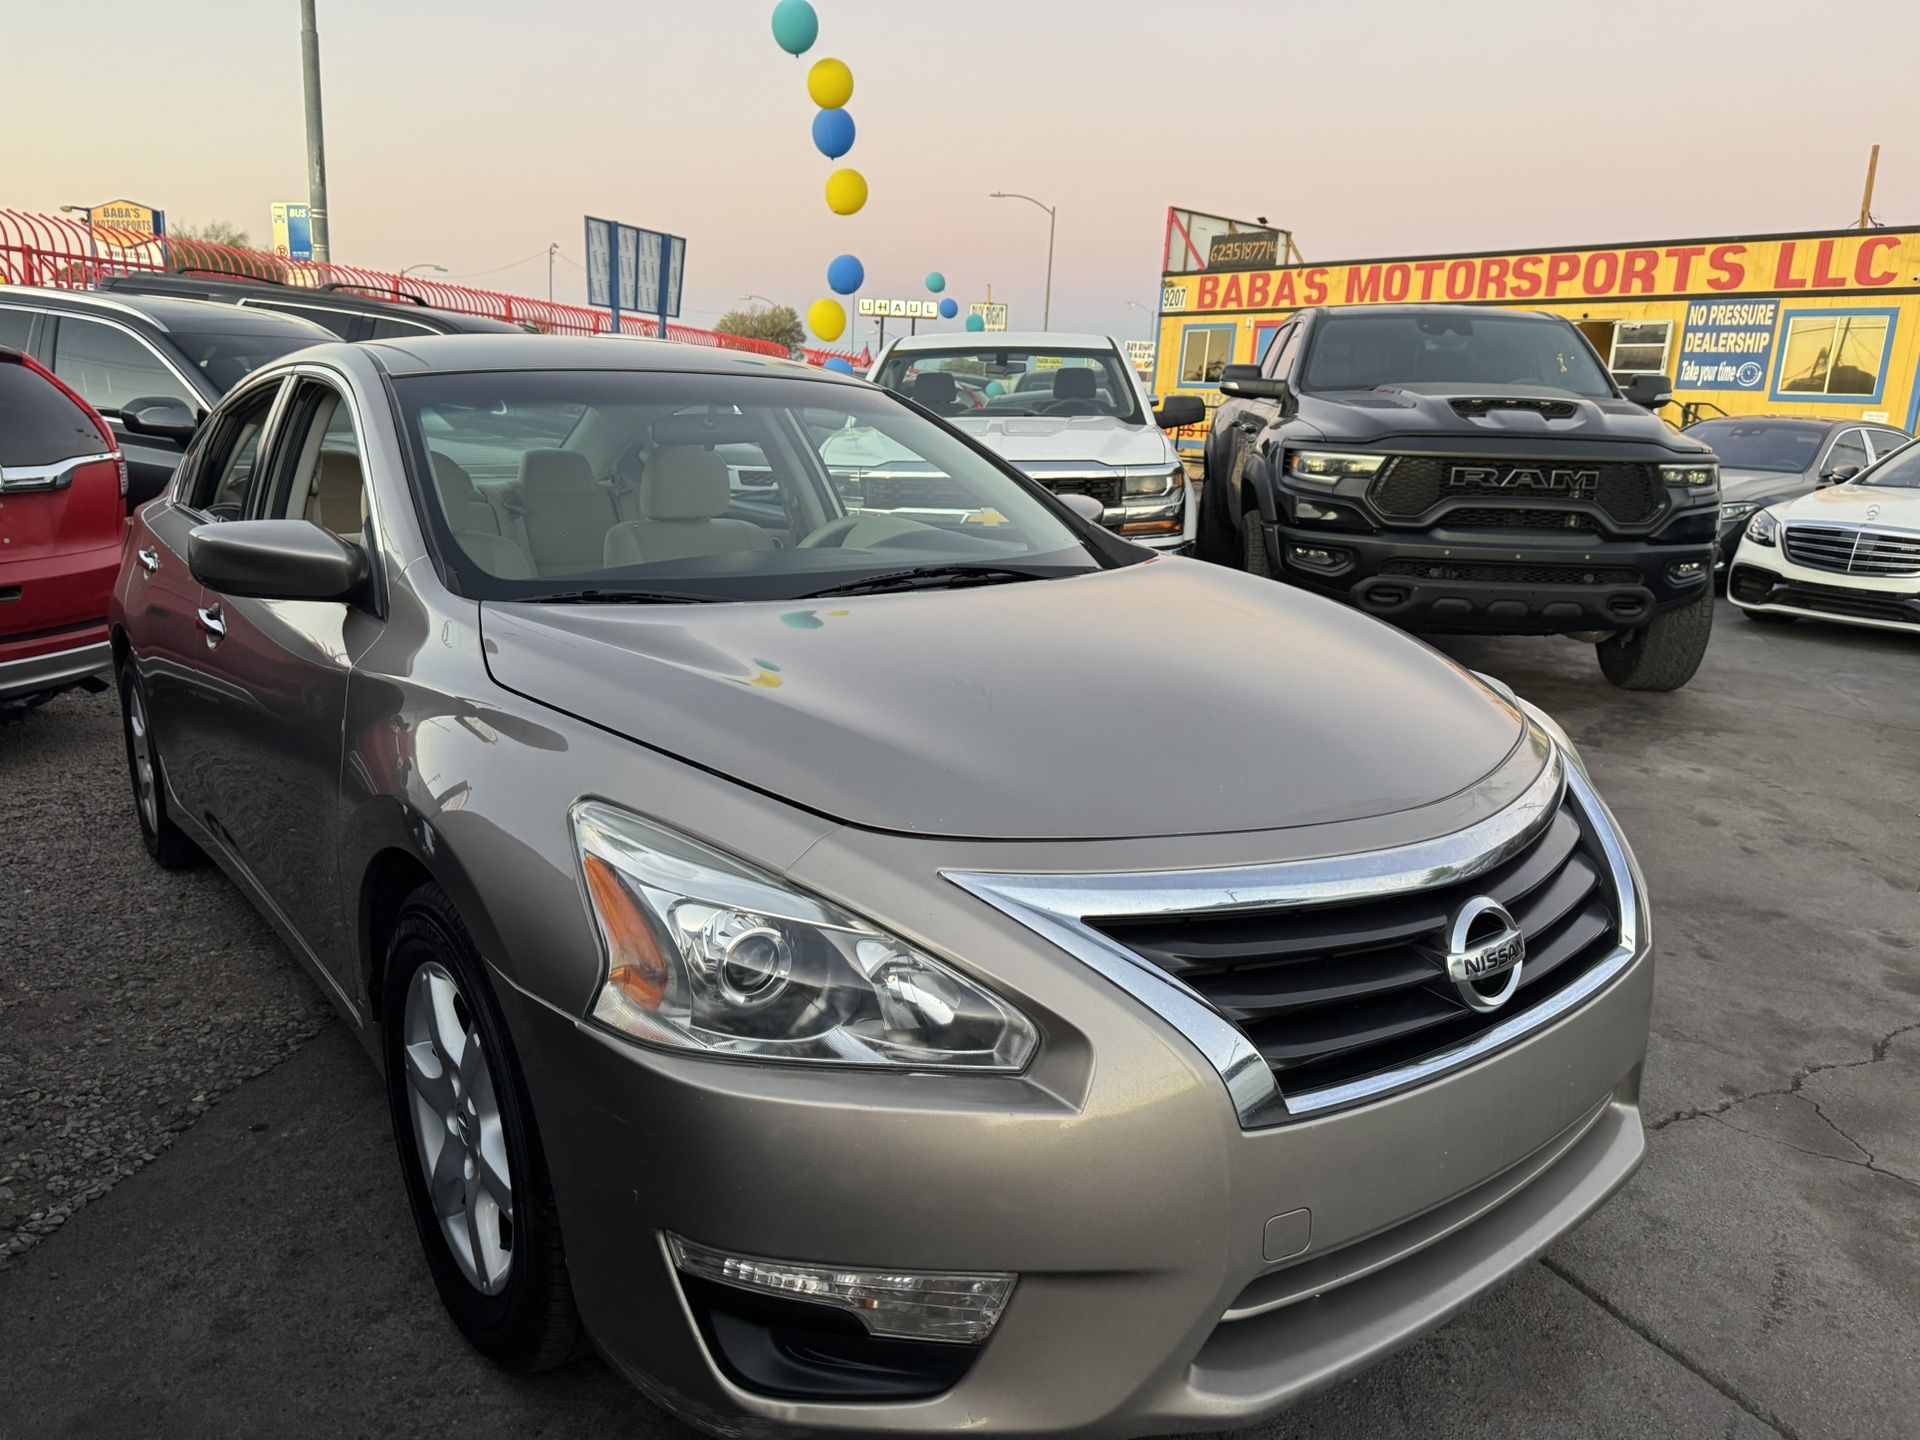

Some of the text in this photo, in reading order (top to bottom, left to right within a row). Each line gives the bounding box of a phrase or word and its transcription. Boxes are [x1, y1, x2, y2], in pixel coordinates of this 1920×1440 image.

[103, 207, 141, 218] BABA'S
[290, 208, 306, 217] BUS
[94, 220, 152, 231] MOTORSPORTS
[1197, 237, 1902, 310] BABA'S MOTORSPORTS LLC
[1164, 288, 1186, 307] 9207
[1688, 304, 1776, 326] NO PRESSURE
[1684, 332, 1770, 353] DEALERSHIP
[1681, 360, 1737, 387] Take your time
[1450, 467, 1600, 490] RAM
[1464, 940, 1524, 976] NISSAN
